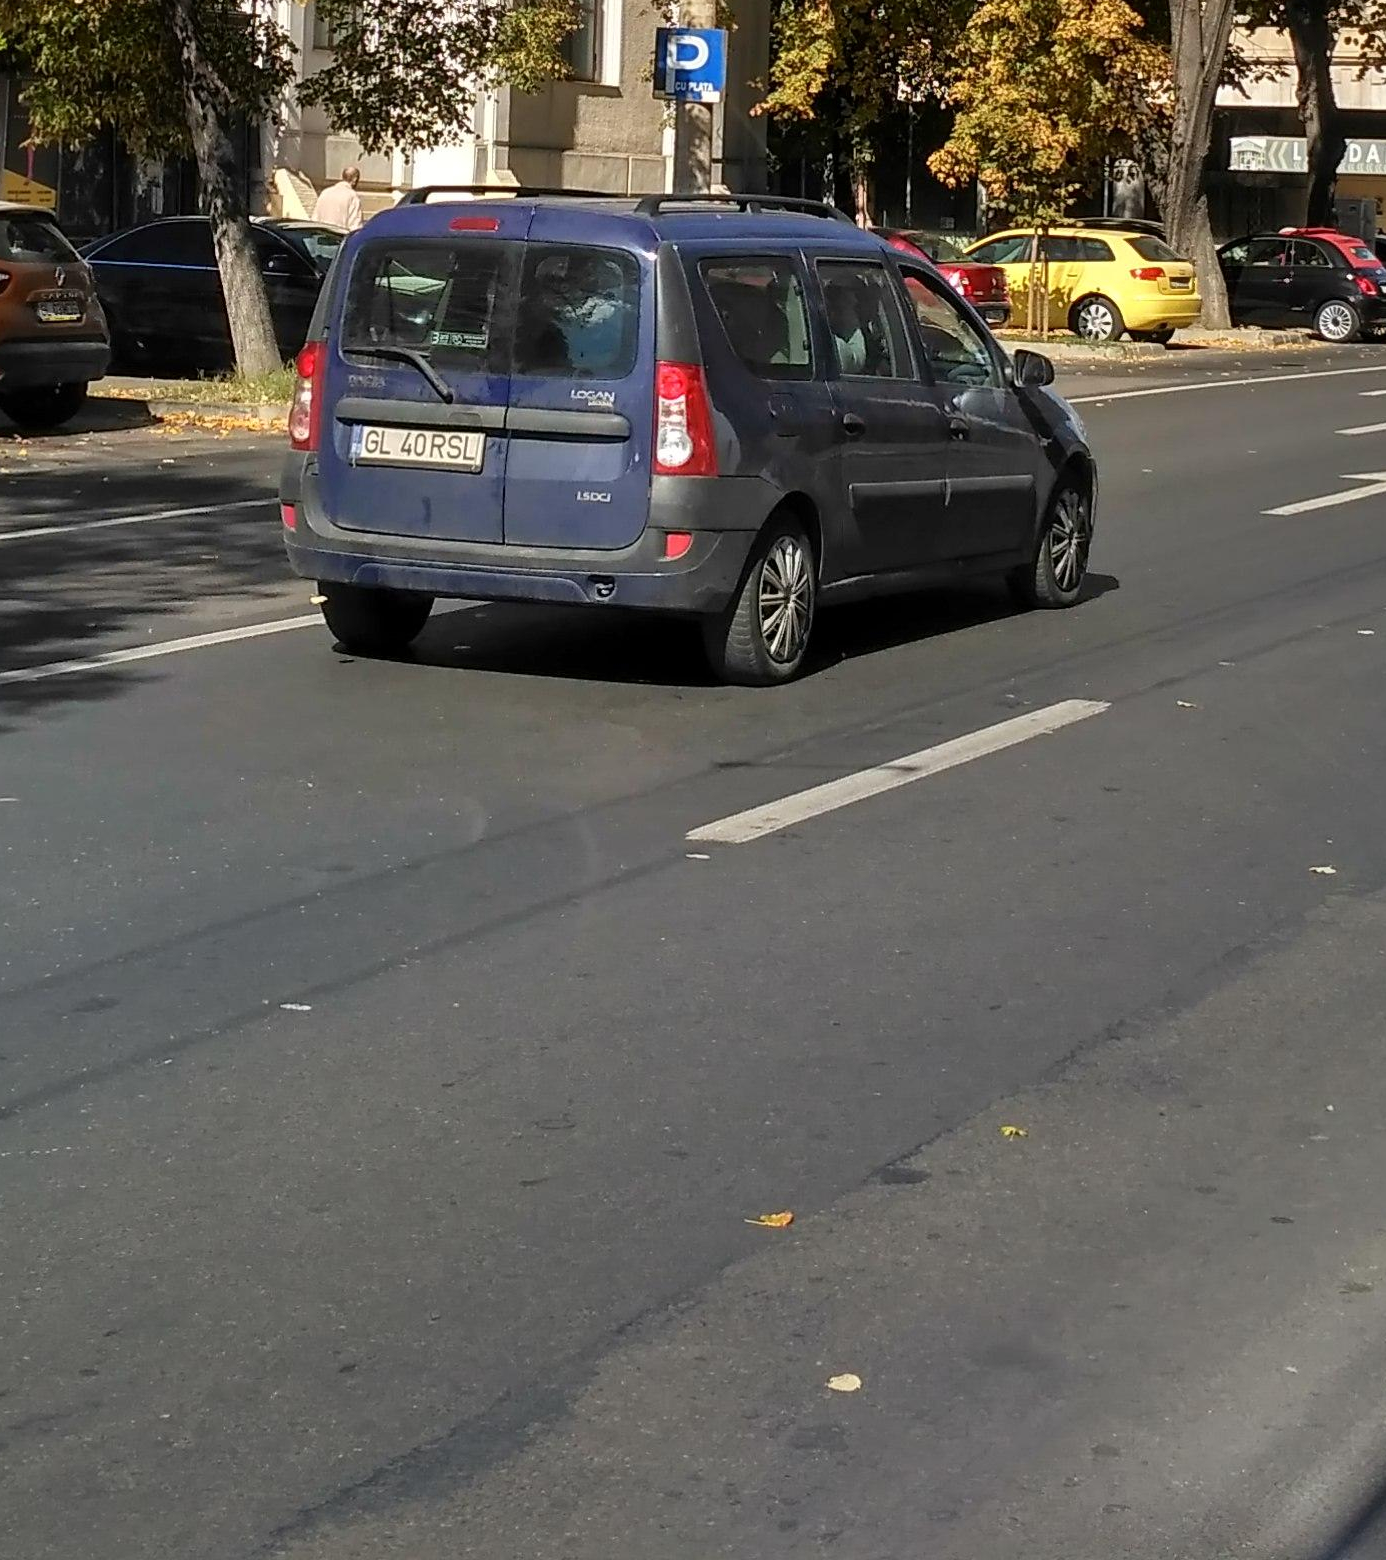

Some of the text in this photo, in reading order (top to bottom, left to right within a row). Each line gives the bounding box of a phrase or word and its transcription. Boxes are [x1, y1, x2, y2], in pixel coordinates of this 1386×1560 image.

[665, 34, 709, 94] P
[675, 82, 687, 91] CU
[570, 389, 615, 403] LOGAN
[364, 430, 391, 455] GL
